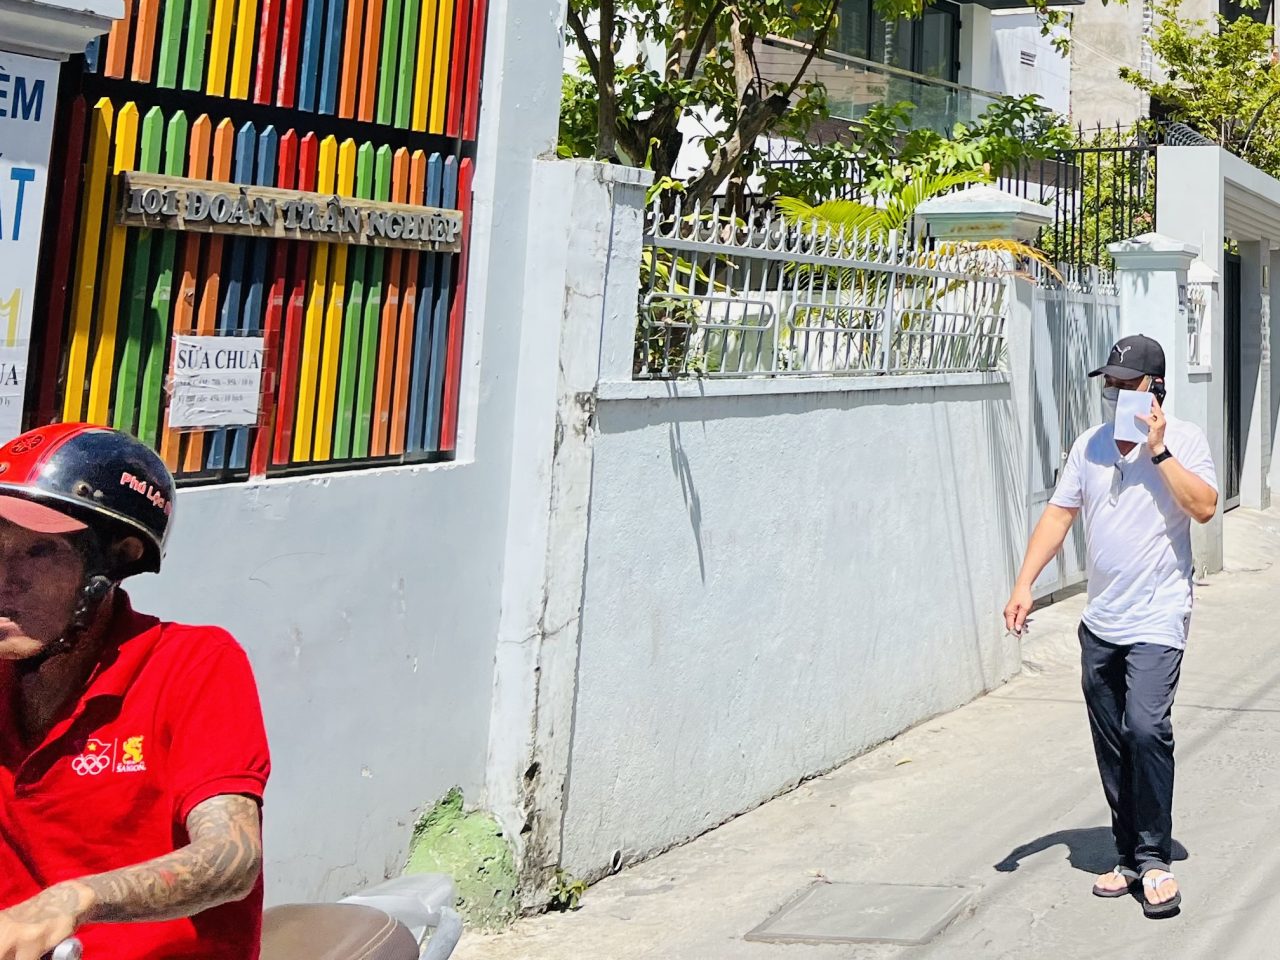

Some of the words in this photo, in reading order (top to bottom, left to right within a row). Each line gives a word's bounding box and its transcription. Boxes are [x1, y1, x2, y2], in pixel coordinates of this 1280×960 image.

[127, 186, 179, 216] 101
[184, 186, 276, 228] ĐOÀN
[366, 210, 463, 250] NGHIỆP
[214, 349, 259, 370] CHUA
